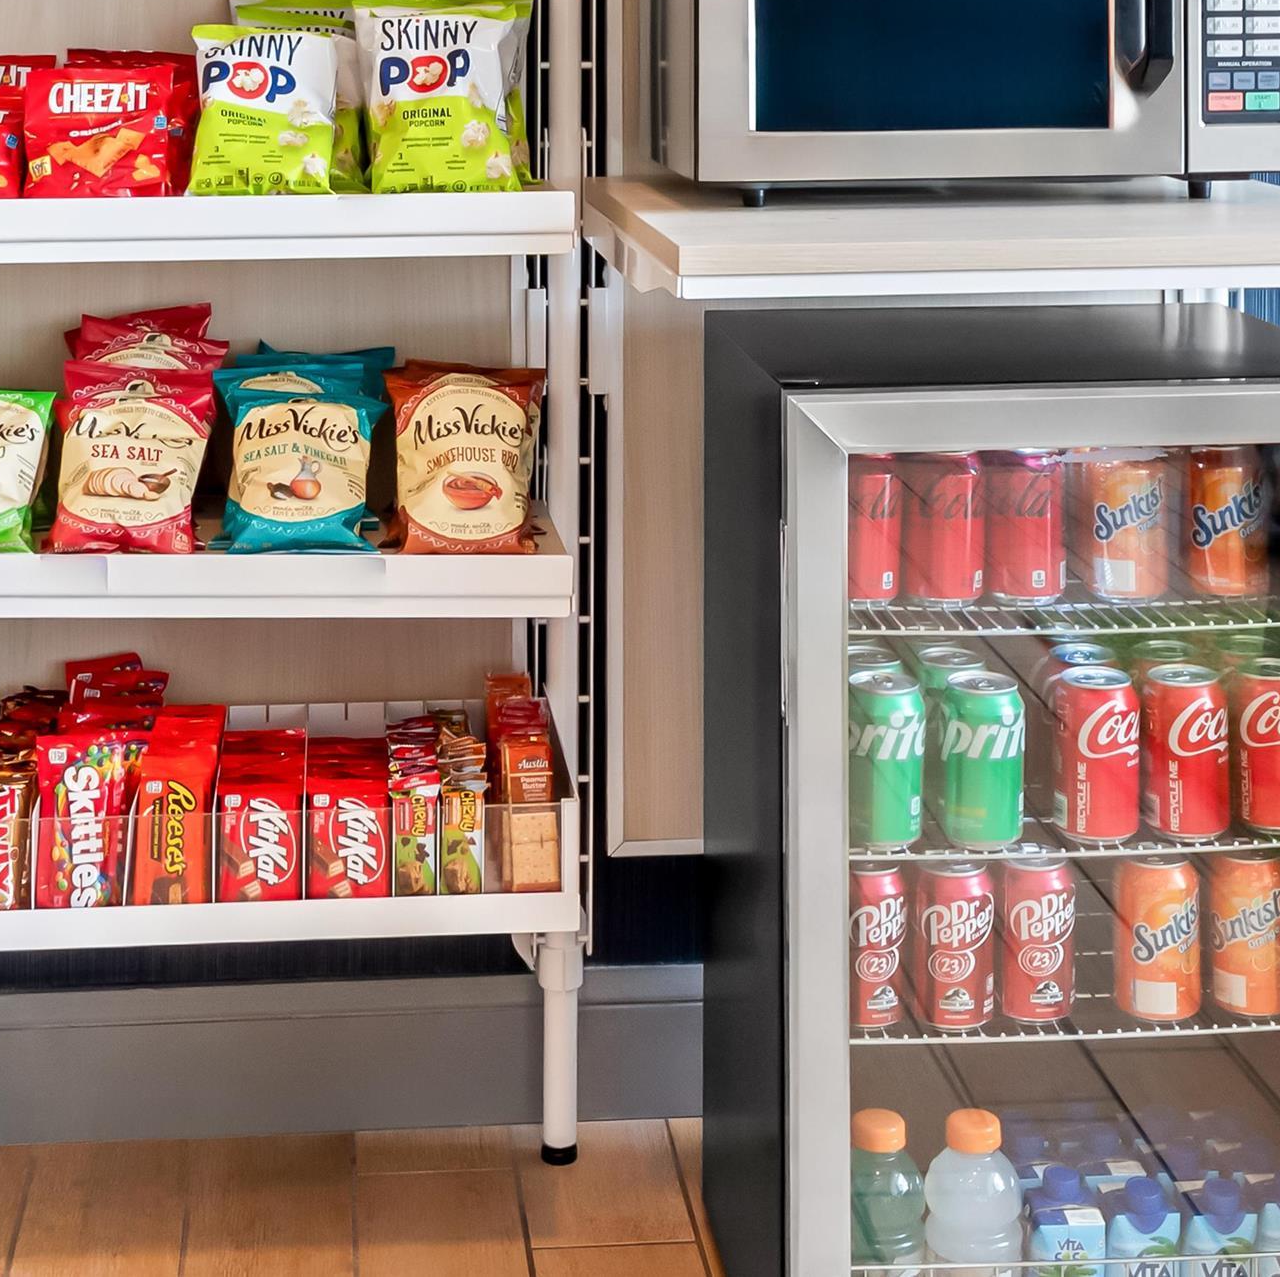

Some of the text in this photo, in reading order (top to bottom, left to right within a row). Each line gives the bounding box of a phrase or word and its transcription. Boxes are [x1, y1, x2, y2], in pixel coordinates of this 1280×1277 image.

[202, 60, 297, 103] POP
[379, 48, 471, 97] POP
[48, 81, 151, 114] CHEEZ-IT
[221, 109, 266, 123] ORIGINAL
[227, 118, 263, 127] POPCORN
[402, 107, 452, 120] ORIGINAL
[409, 119, 445, 128] POPCORN
[238, 418, 291, 448] Miss
[286, 405, 360, 453] Vickie's
[413, 403, 524, 451] Miss Vickie's
[91, 443, 163, 462] SEA SALT
[243, 442, 347, 467] SEA SALT & VINEGAR
[426, 446, 519, 475] SMOKEHOUSE BBQ
[1094, 475, 1164, 543] Sunkist
[1191, 480, 1264, 550] Sunkis
[518, 758, 549, 770] Austin
[520, 776, 547, 784] Peanut
[522, 782, 546, 790] Butter
[1240, 749, 1251, 820] RECYCLE ME
[1076, 762, 1087, 833] RECYCLE ME
[1169, 760, 1180, 832] RECYCLE ME
[63, 765, 104, 908] Skittles
[165, 779, 197, 876] Reese's
[880, 896, 904, 925] Dr
[951, 898, 980, 927] Dr
[1042, 891, 1067, 919] Dr
[922, 904, 992, 948] Pepper
[869, 953, 887, 972] 23
[942, 955, 960, 972] 23
[1032, 951, 1050, 968] 23
[1056, 1237, 1085, 1251] VITA
[1128, 1260, 1169, 1277] VITA
[1201, 1260, 1248, 1277] VITA
